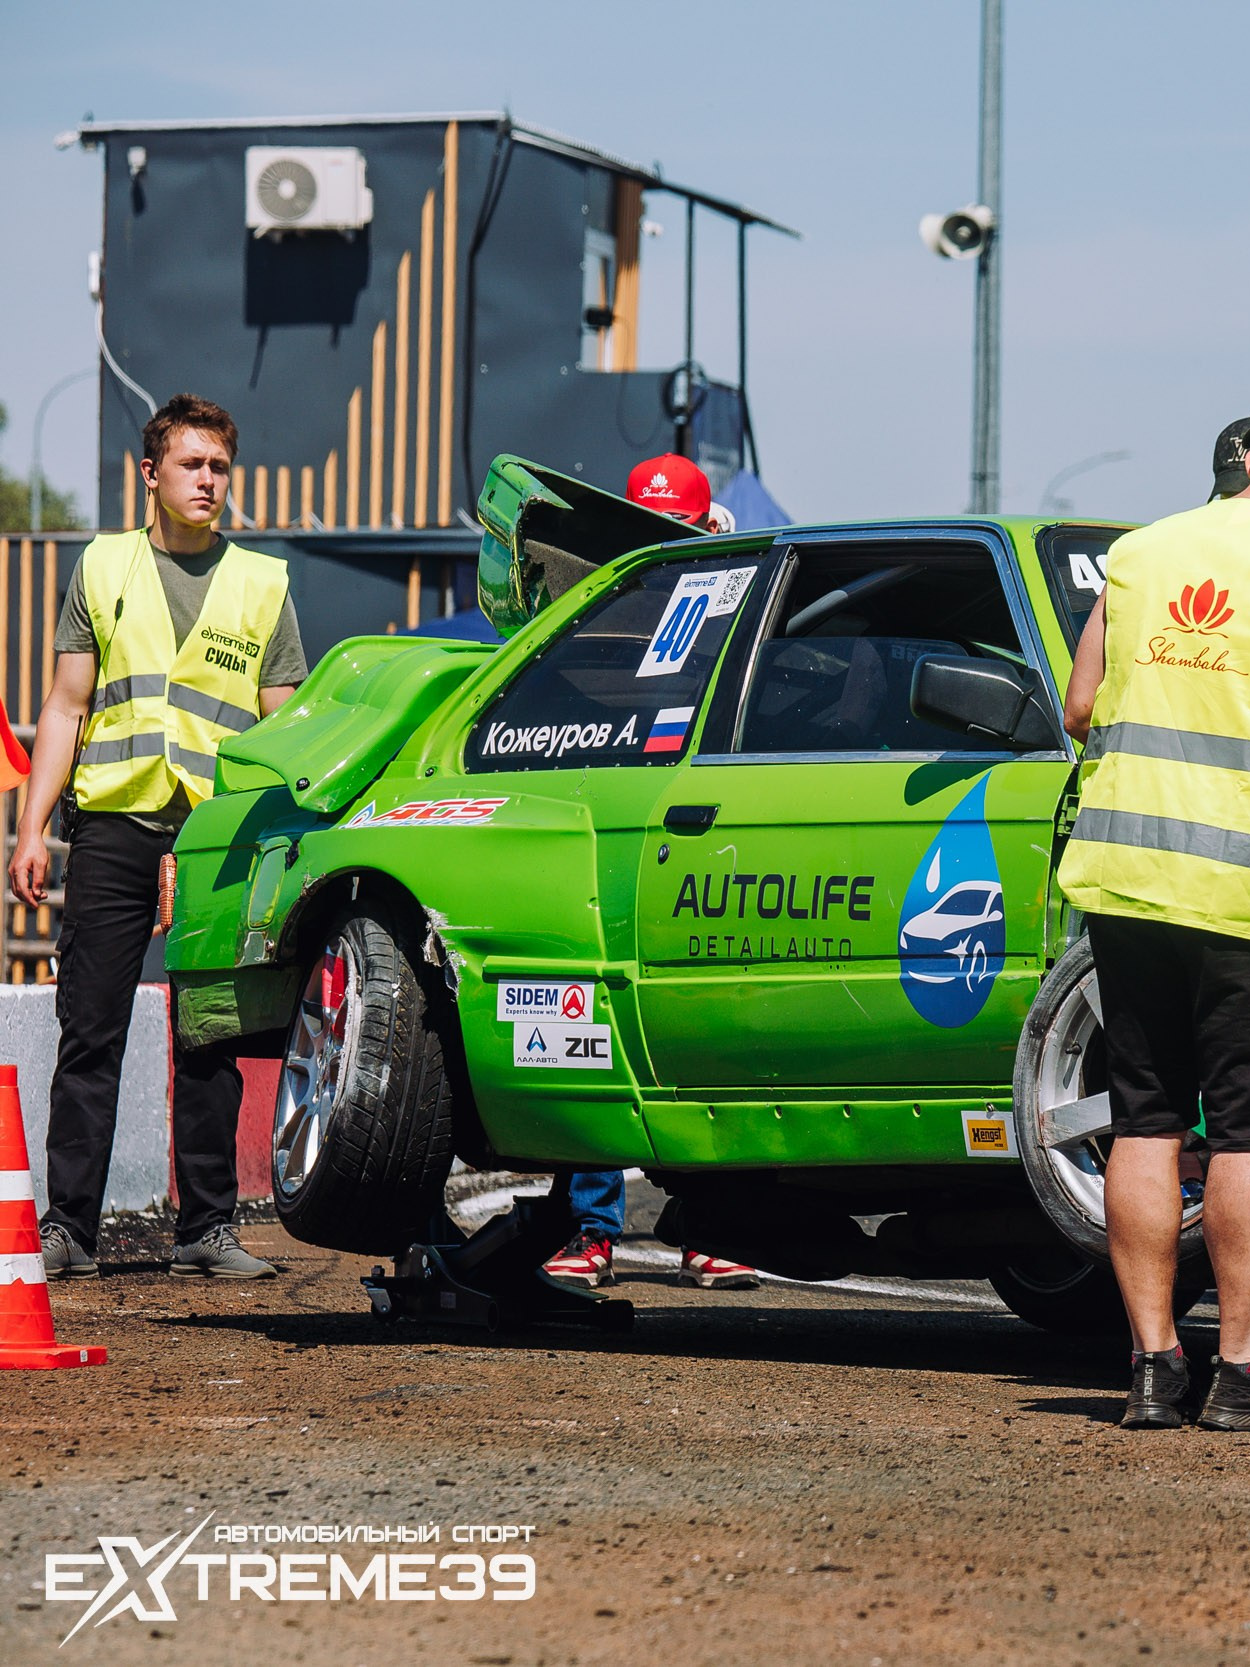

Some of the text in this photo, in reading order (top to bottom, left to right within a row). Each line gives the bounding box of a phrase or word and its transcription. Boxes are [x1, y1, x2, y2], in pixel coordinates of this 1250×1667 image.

[652, 593, 709, 663] 40
[204, 646, 247, 675] СУДЬЯ
[1134, 636, 1249, 676] Shambala
[482, 714, 639, 757] Кожеуров А.
[671, 873, 876, 921] AUTOLIFE
[688, 935, 852, 960] DETAILAUTO
[505, 987, 559, 1006] SIDEM
[505, 1008, 528, 1016] Experts
[565, 1037, 609, 1058] ZIC
[971, 1127, 1002, 1142] Hengst
